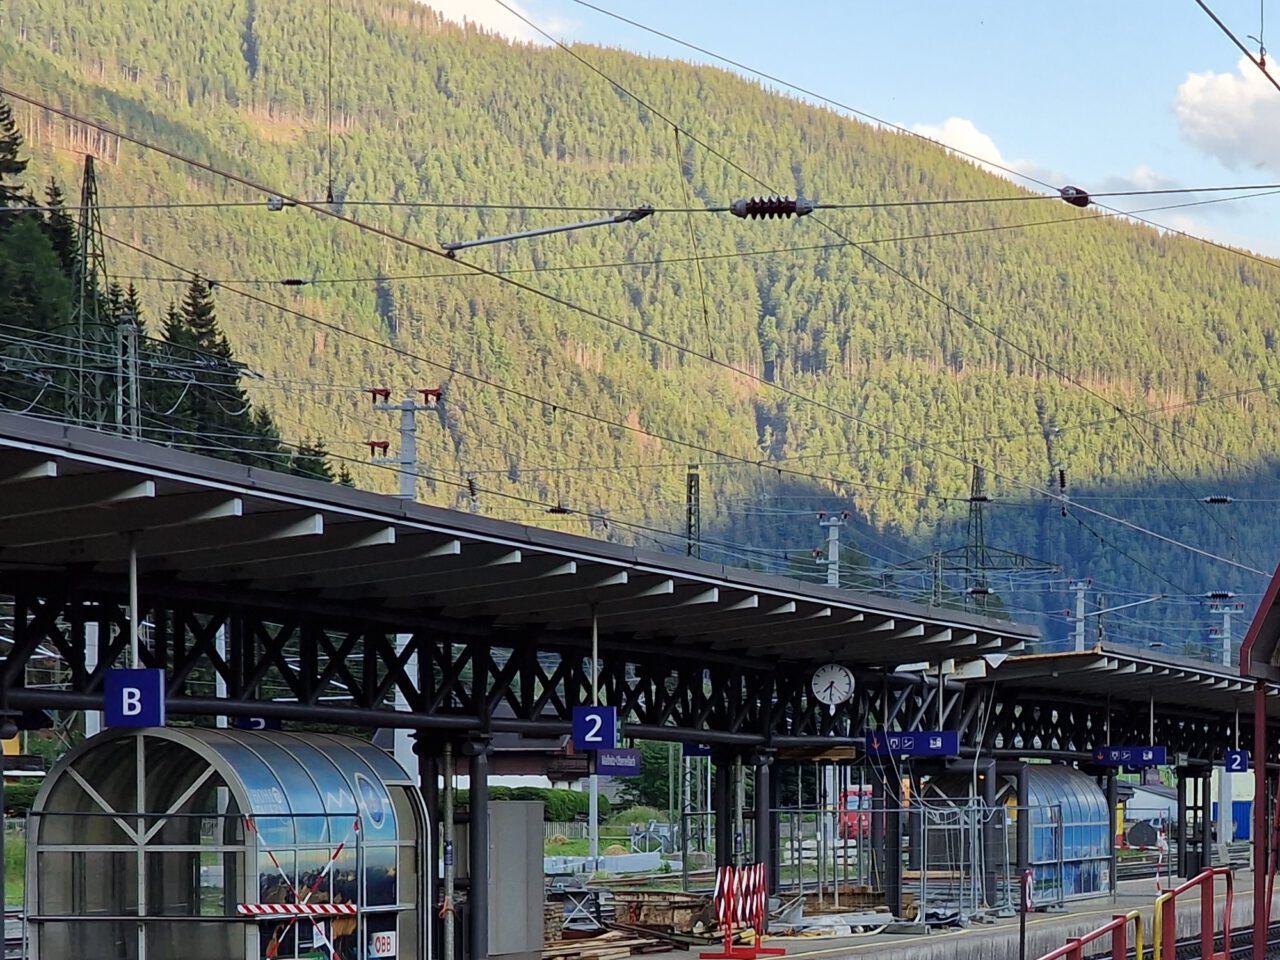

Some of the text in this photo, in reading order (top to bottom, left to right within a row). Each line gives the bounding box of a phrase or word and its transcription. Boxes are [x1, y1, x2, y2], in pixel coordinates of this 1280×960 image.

[122, 687, 142, 716] B
[584, 713, 603, 742] 2
[1231, 754, 1241, 770] 2
